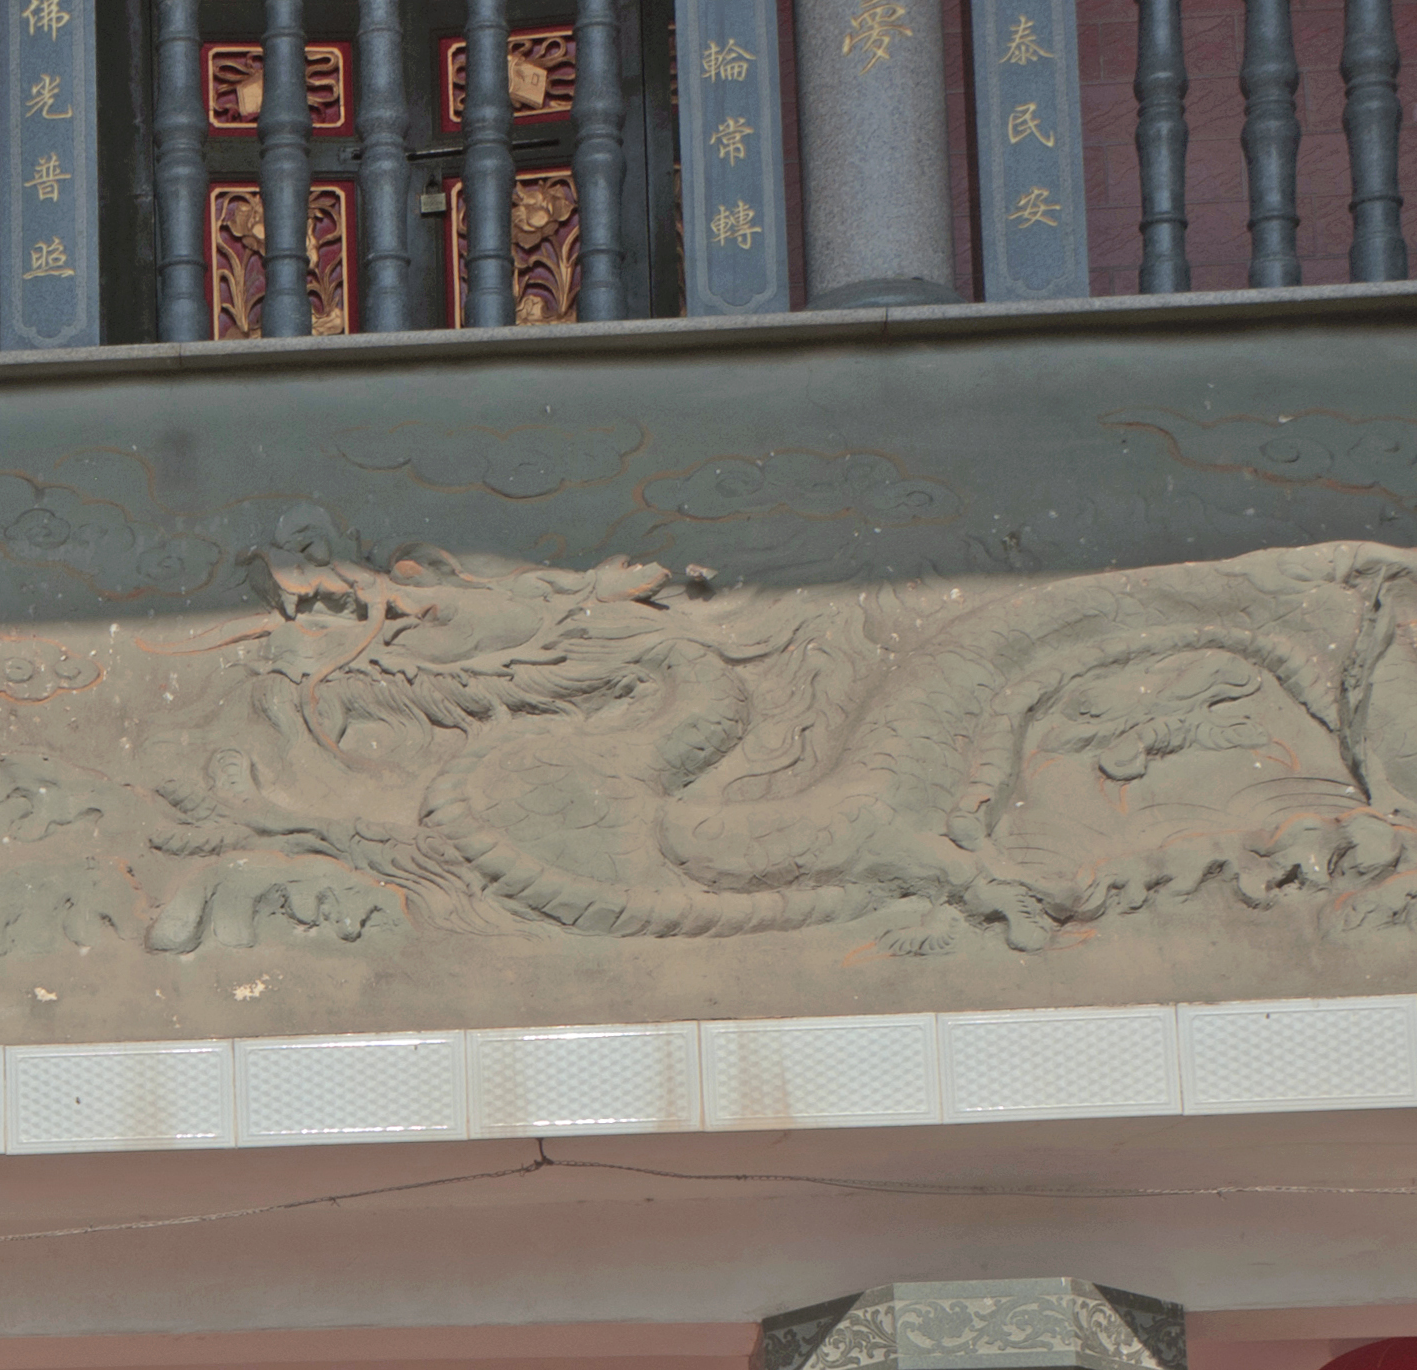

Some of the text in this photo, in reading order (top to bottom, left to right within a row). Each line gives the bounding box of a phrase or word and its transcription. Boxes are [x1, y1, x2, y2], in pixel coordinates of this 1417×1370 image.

[22, 0, 75, 280] 佛光普照
[701, 38, 762, 250] 輪常轉
[999, 15, 1062, 230] 泰民安
